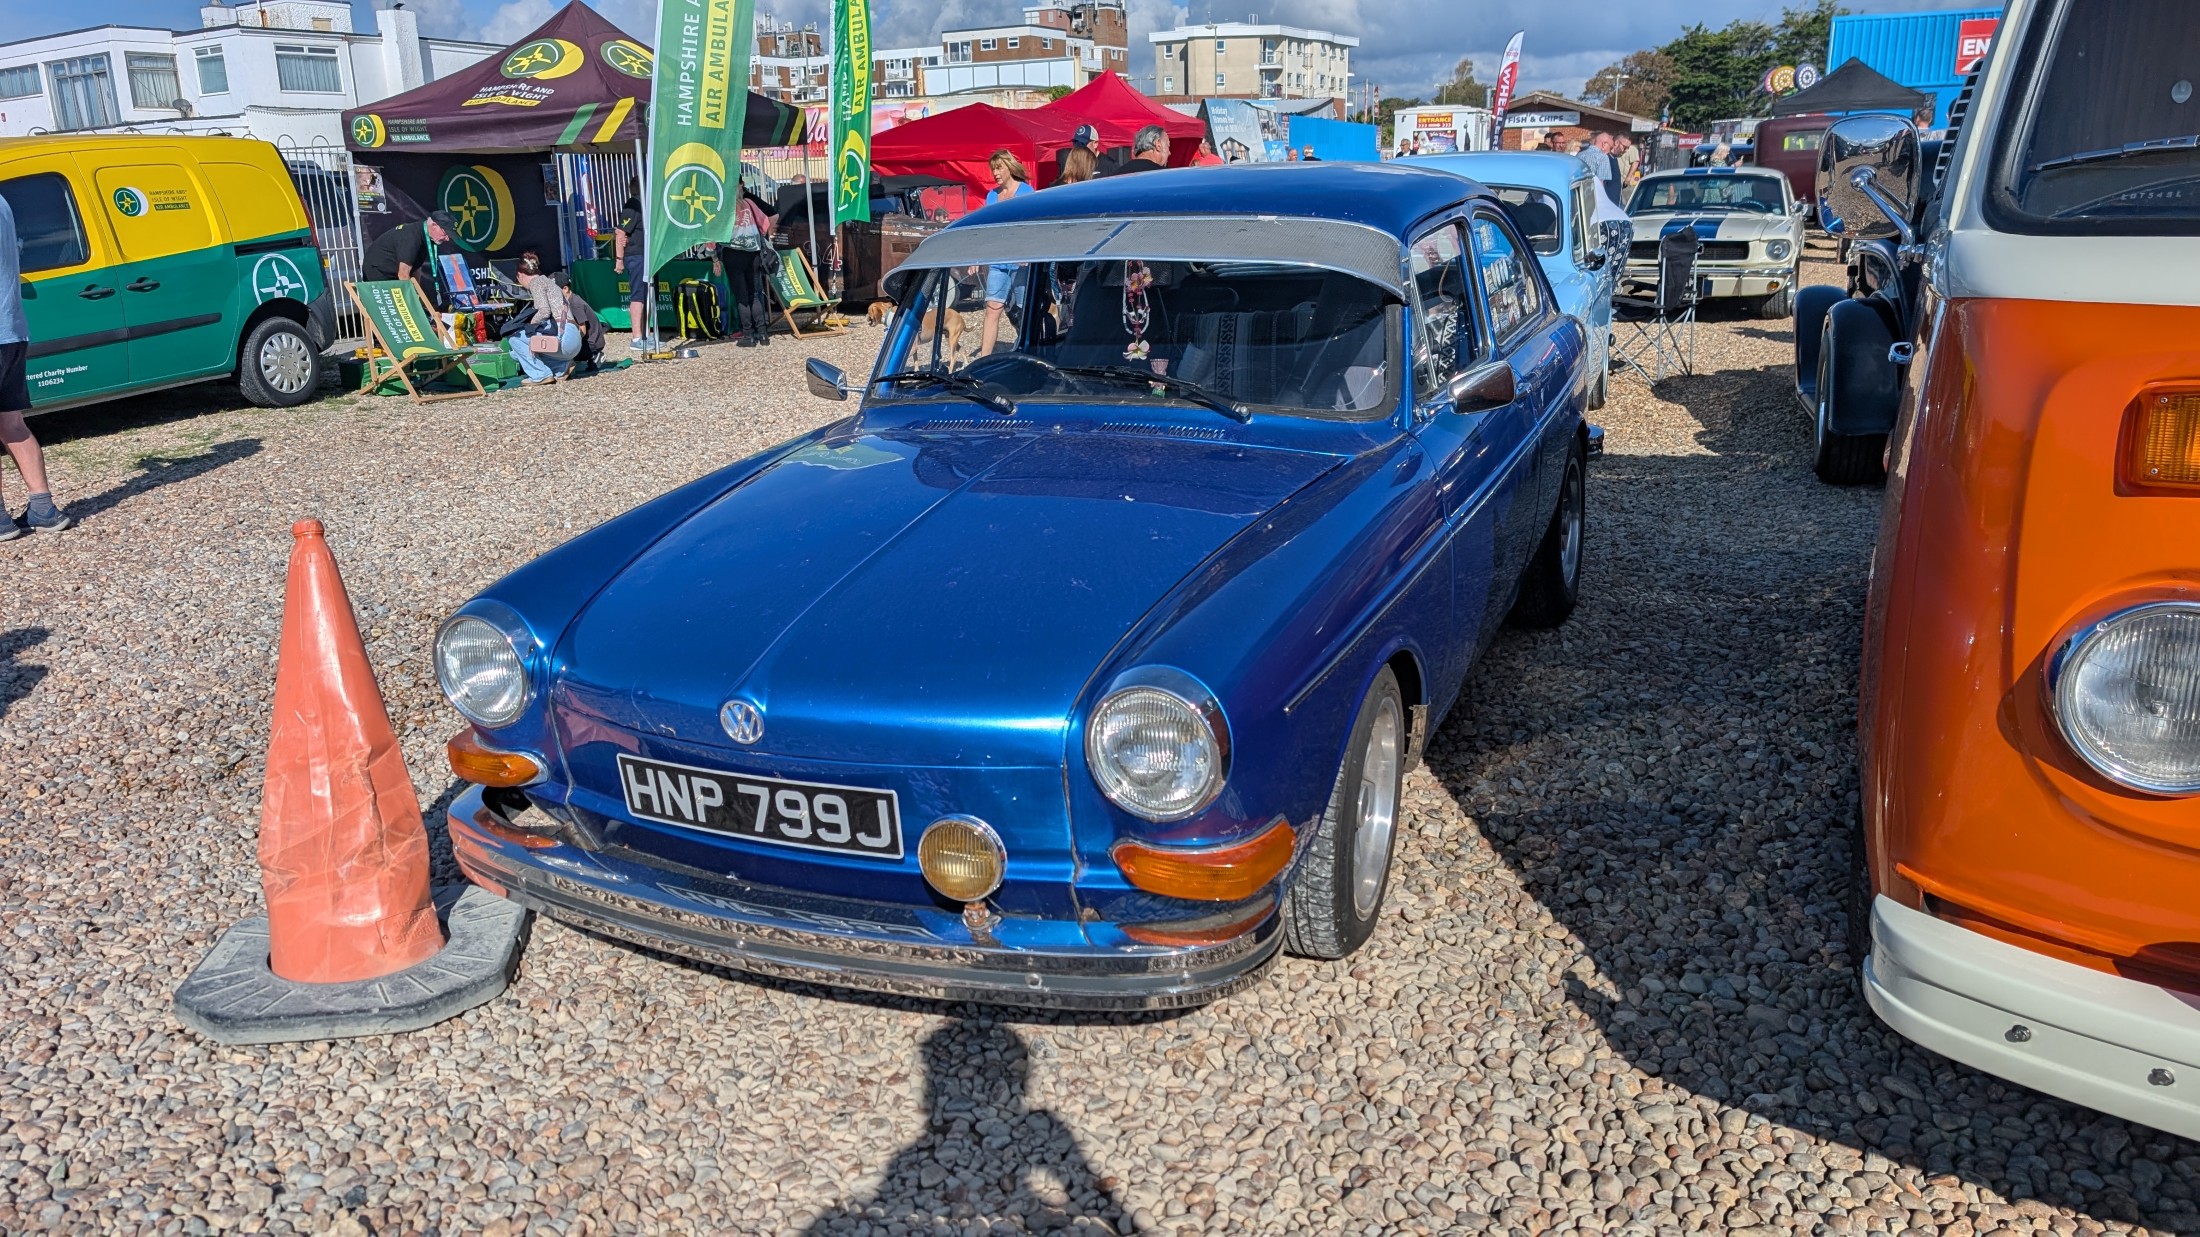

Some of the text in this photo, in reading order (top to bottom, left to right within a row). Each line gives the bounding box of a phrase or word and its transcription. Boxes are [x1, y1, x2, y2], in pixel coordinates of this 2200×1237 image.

[677, 13, 700, 126] HAMPSHIRE
[705, 0, 730, 123] AIR AMBULA
[850, 0, 866, 107] AIR AMBULA
[1963, 38, 1991, 56] EN
[479, 83, 555, 95] HAMPSHIRE AND
[511, 90, 549, 100] WIGHT
[1492, 67, 1512, 151] WHEELERS
[1508, 116, 1527, 124] FISH
[373, 288, 403, 344] HAMPSHIRE AND
[382, 289, 413, 343] ISLE OF WIGHT
[393, 290, 422, 340] AIR AMBULANCE
[26, 365, 88, 380] tered Charity Number
[38, 377, 64, 387] 1106234
[626, 764, 891, 848] HNP 799J
